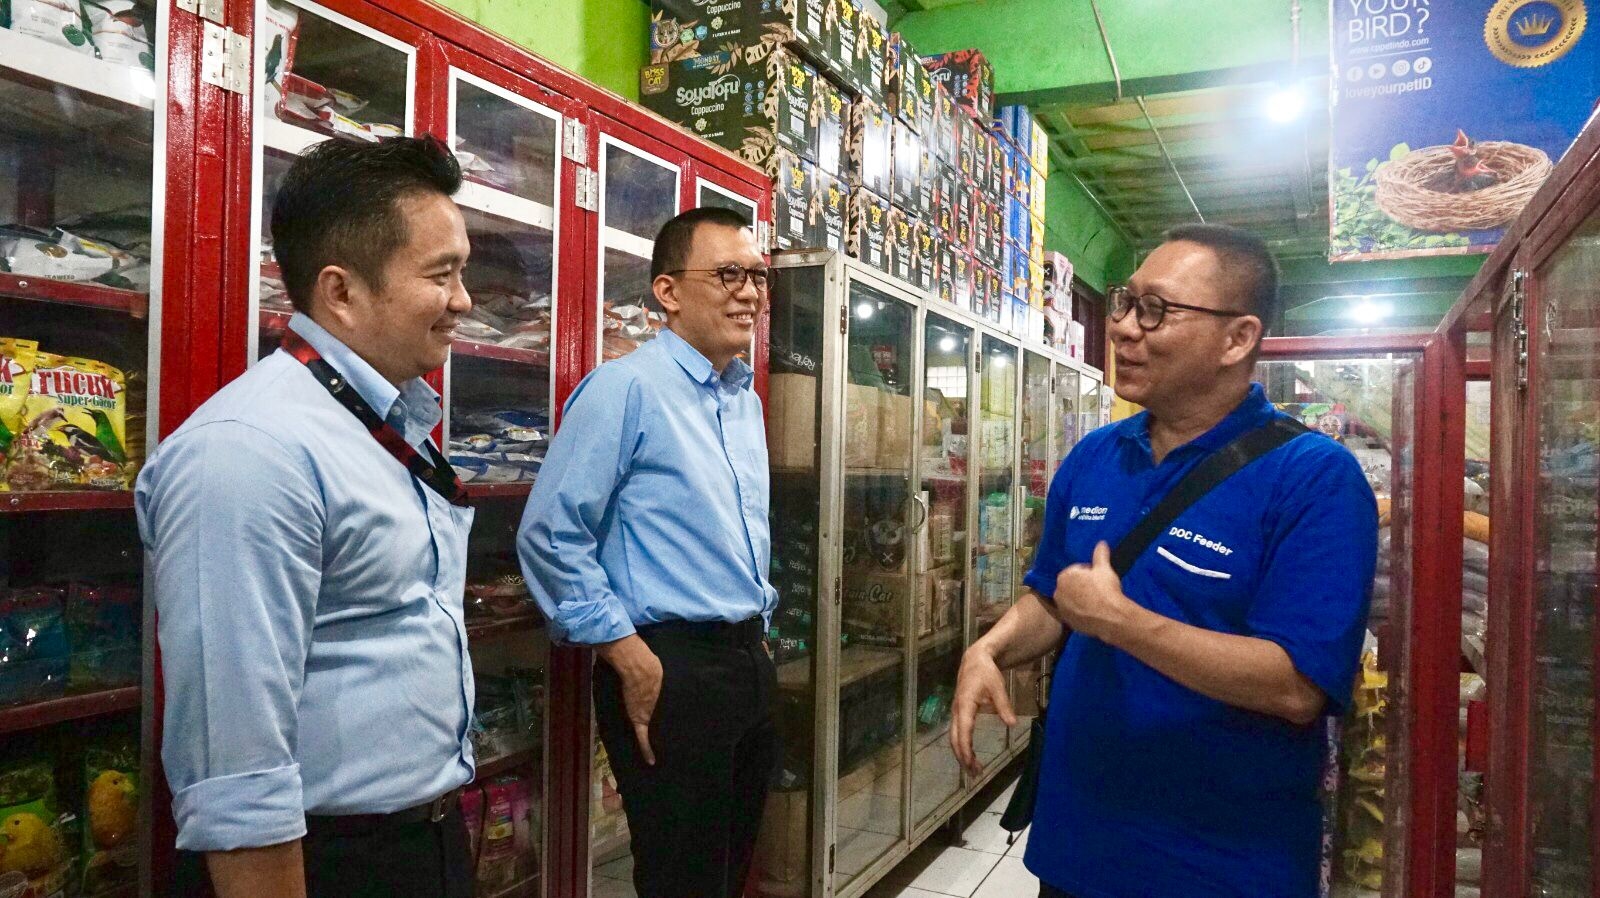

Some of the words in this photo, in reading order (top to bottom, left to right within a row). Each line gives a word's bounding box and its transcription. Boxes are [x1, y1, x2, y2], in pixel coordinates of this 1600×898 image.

[706, 1, 742, 16] Cappuccino
[1349, 13, 1411, 44] BIRD
[691, 102, 725, 117] Cappuccino
[1169, 527, 1192, 541] DOC
[1193, 535, 1233, 557] Feeder
